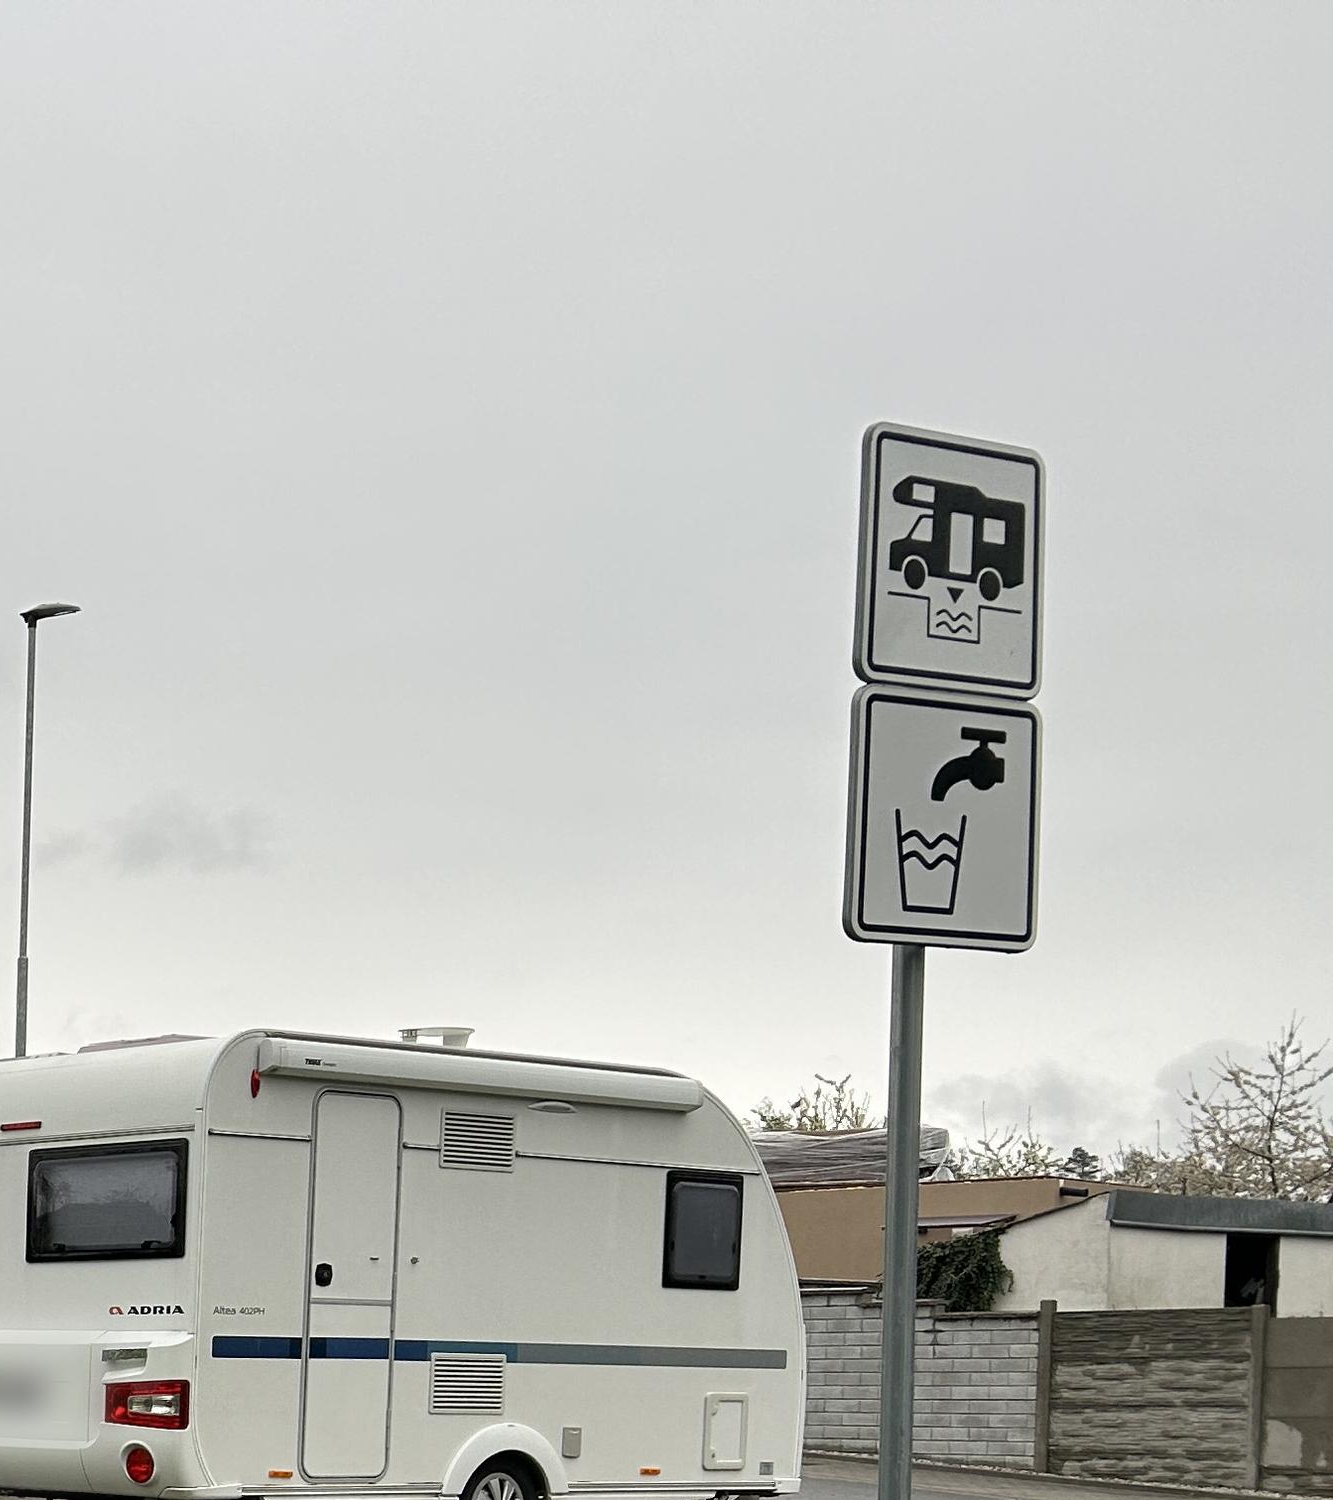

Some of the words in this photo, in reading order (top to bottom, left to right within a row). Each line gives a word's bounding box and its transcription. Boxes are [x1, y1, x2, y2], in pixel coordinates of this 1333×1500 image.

[127, 1305, 184, 1315] ADRIA
[212, 1305, 237, 1316] Altea
[239, 1306, 266, 1316] 402PH
